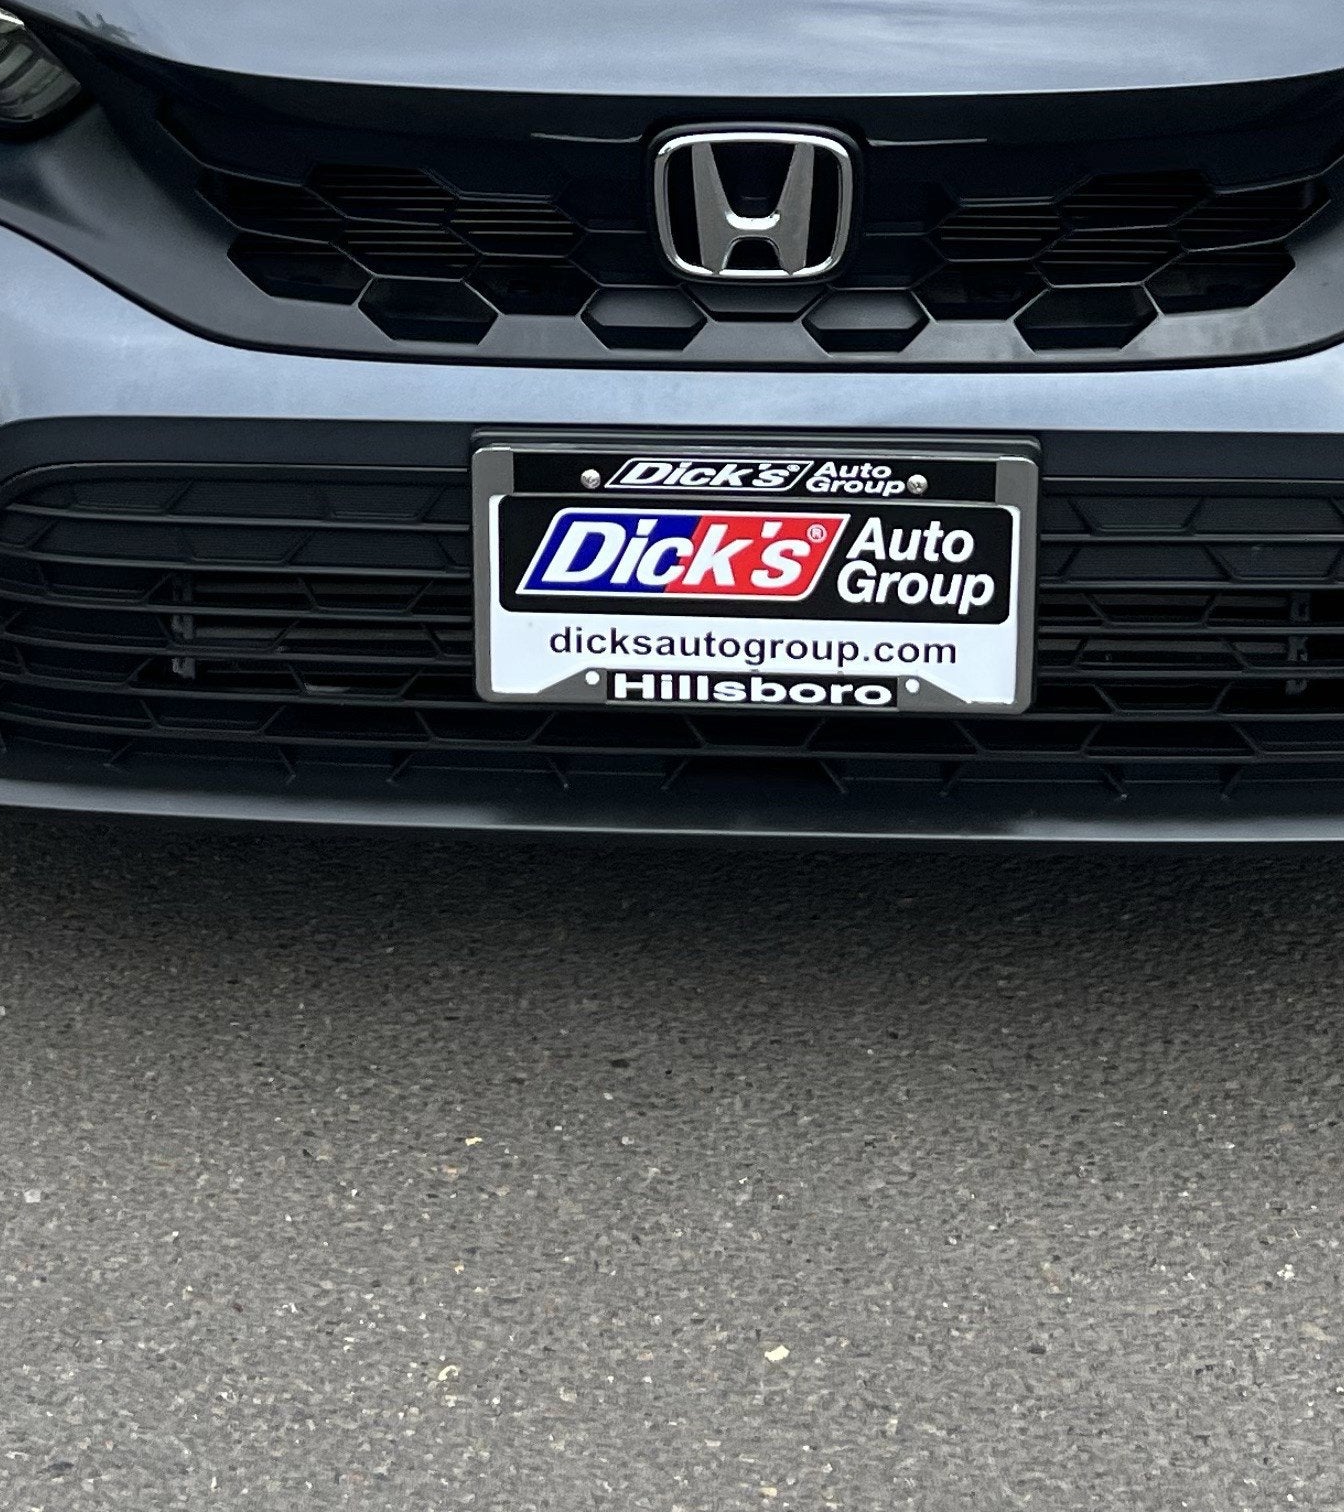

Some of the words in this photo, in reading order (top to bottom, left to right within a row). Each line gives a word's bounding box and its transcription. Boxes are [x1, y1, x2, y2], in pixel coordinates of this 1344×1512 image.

[619, 461, 791, 487] Dick's
[806, 476, 905, 497] Group
[813, 461, 892, 479] Auto
[541, 518, 809, 588] Dick's
[846, 517, 974, 562] Auto
[837, 559, 994, 614] Group
[549, 627, 957, 667] dicksautogroup.com
[614, 672, 892, 706] Hillsboro
